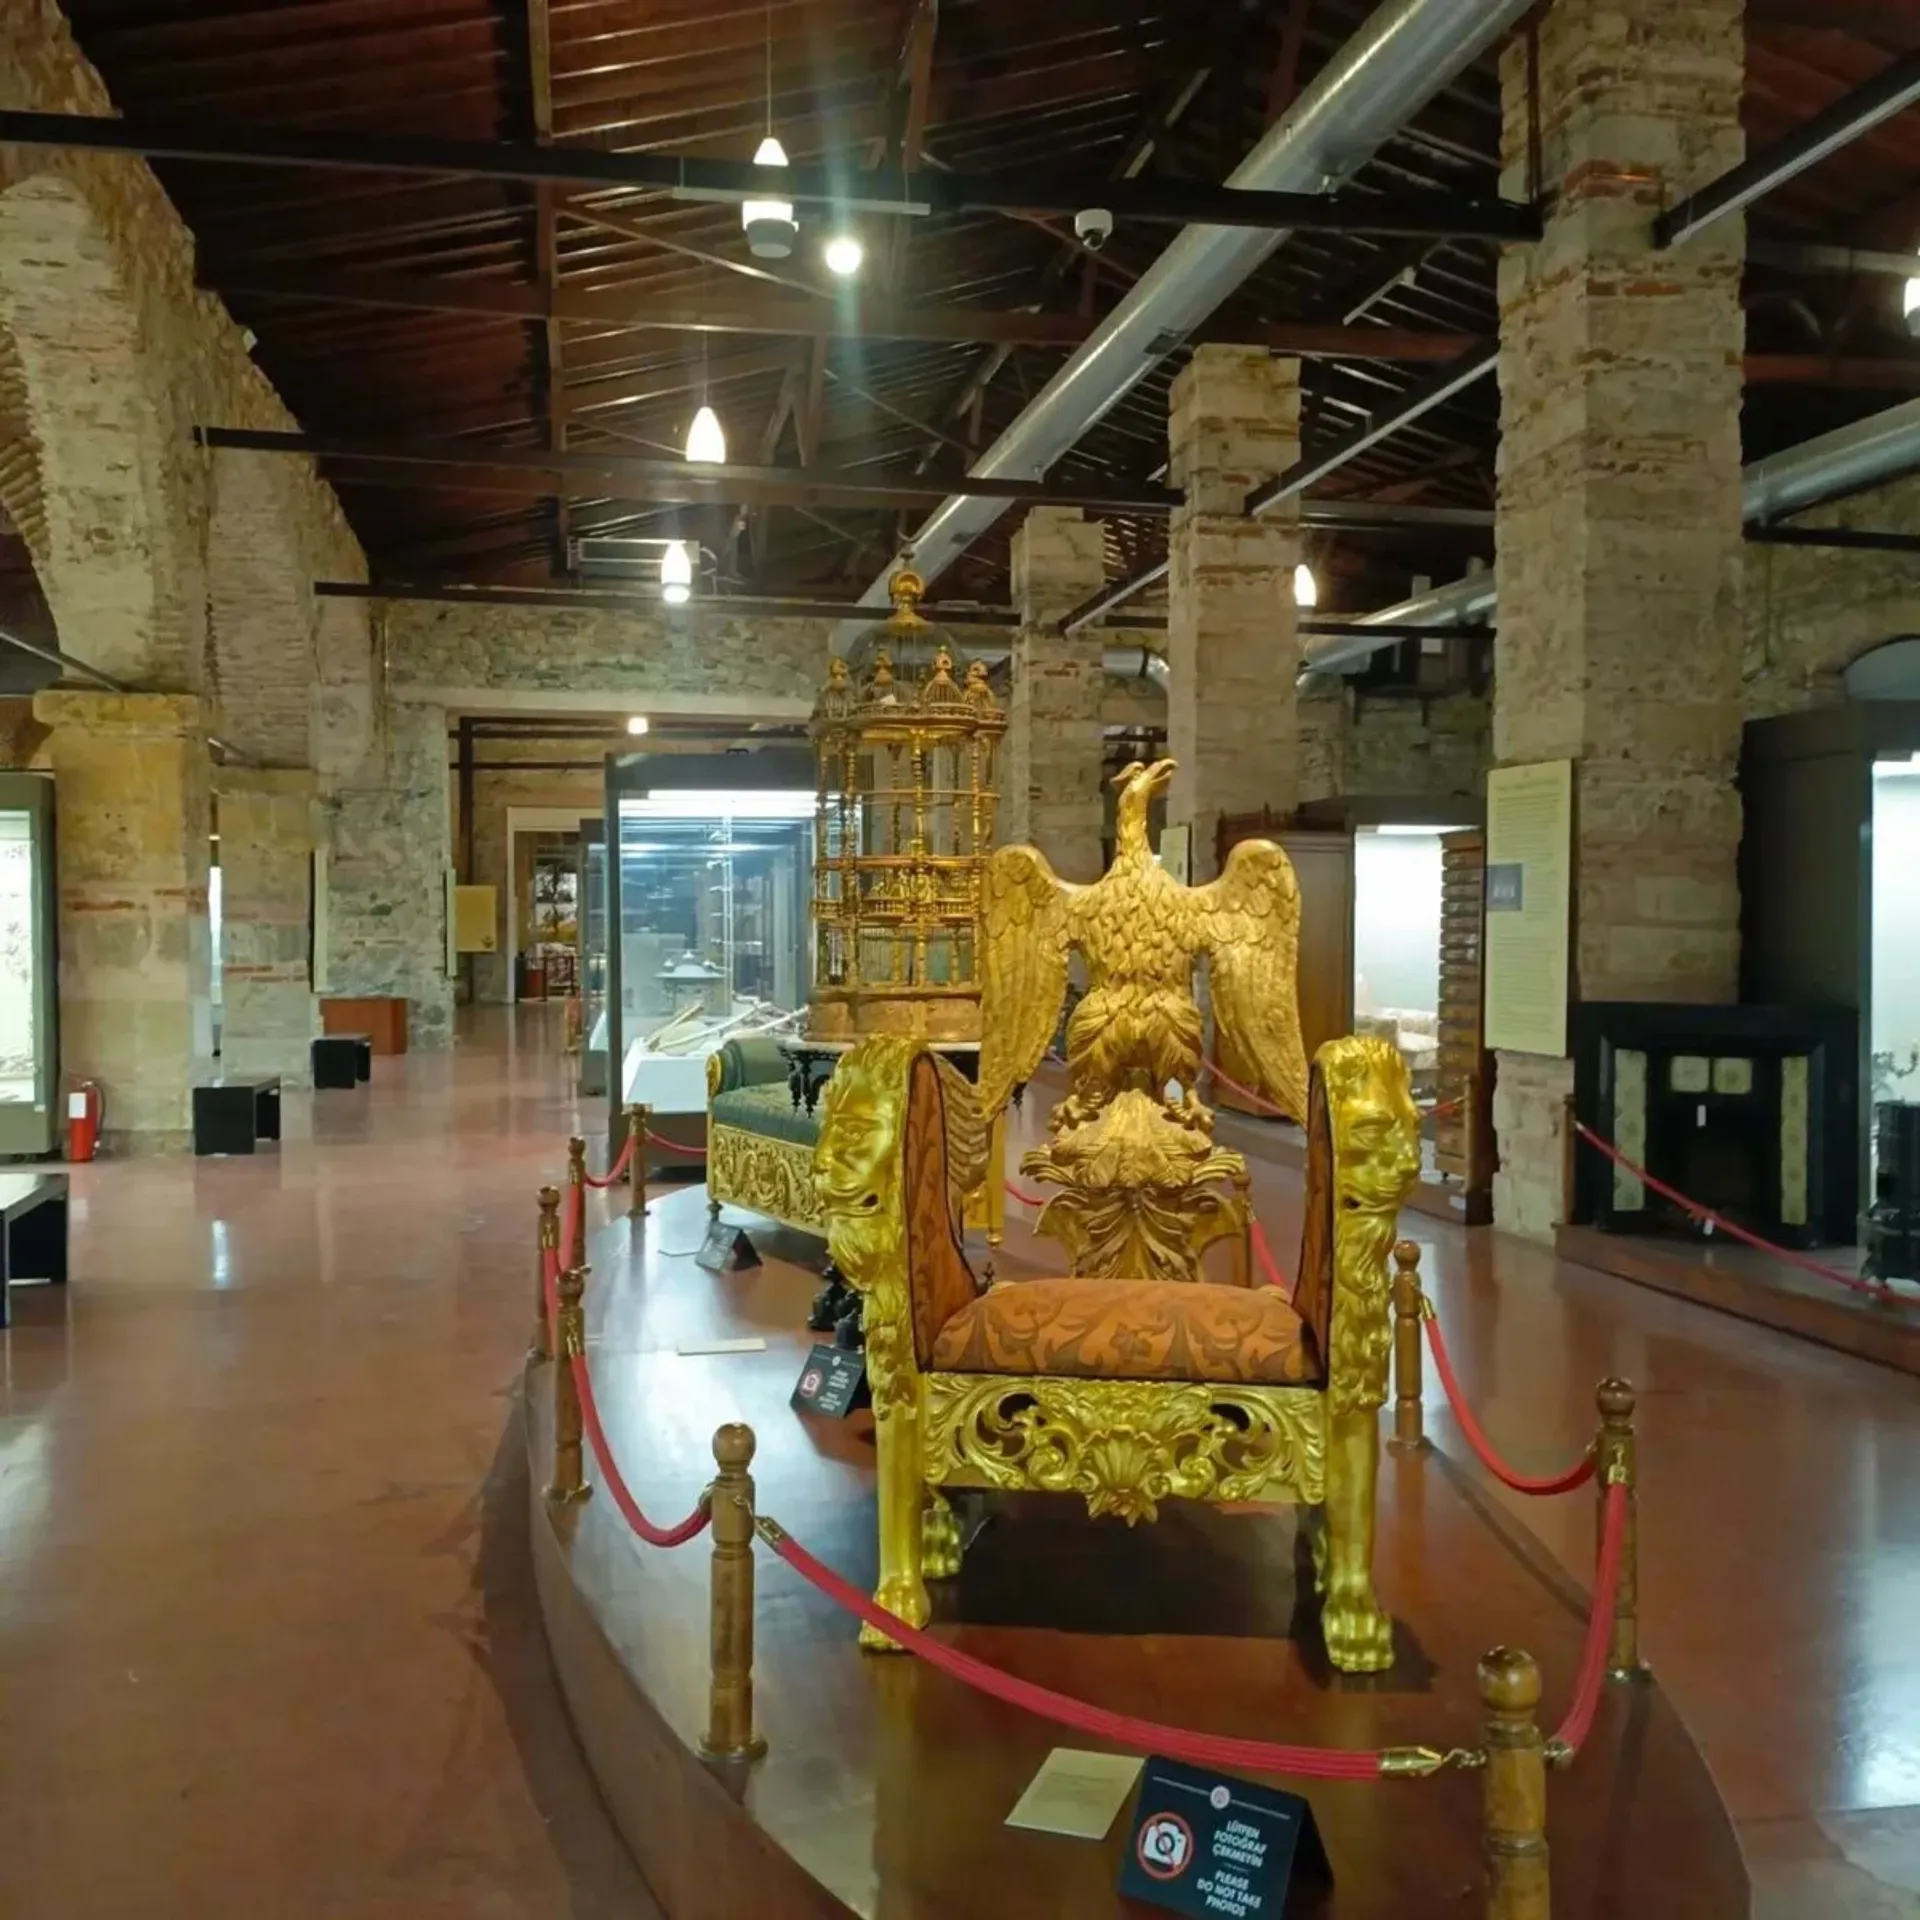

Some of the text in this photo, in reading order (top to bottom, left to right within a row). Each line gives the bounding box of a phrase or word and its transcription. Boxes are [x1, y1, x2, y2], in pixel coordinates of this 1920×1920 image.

[1214, 1830, 1268, 1855] FOTOĞRAF
[1215, 1870, 1249, 1891] PLEASE
[1197, 1878, 1262, 1909] DO NOT TAKE
[1205, 1895, 1246, 1917] PHOTOS
